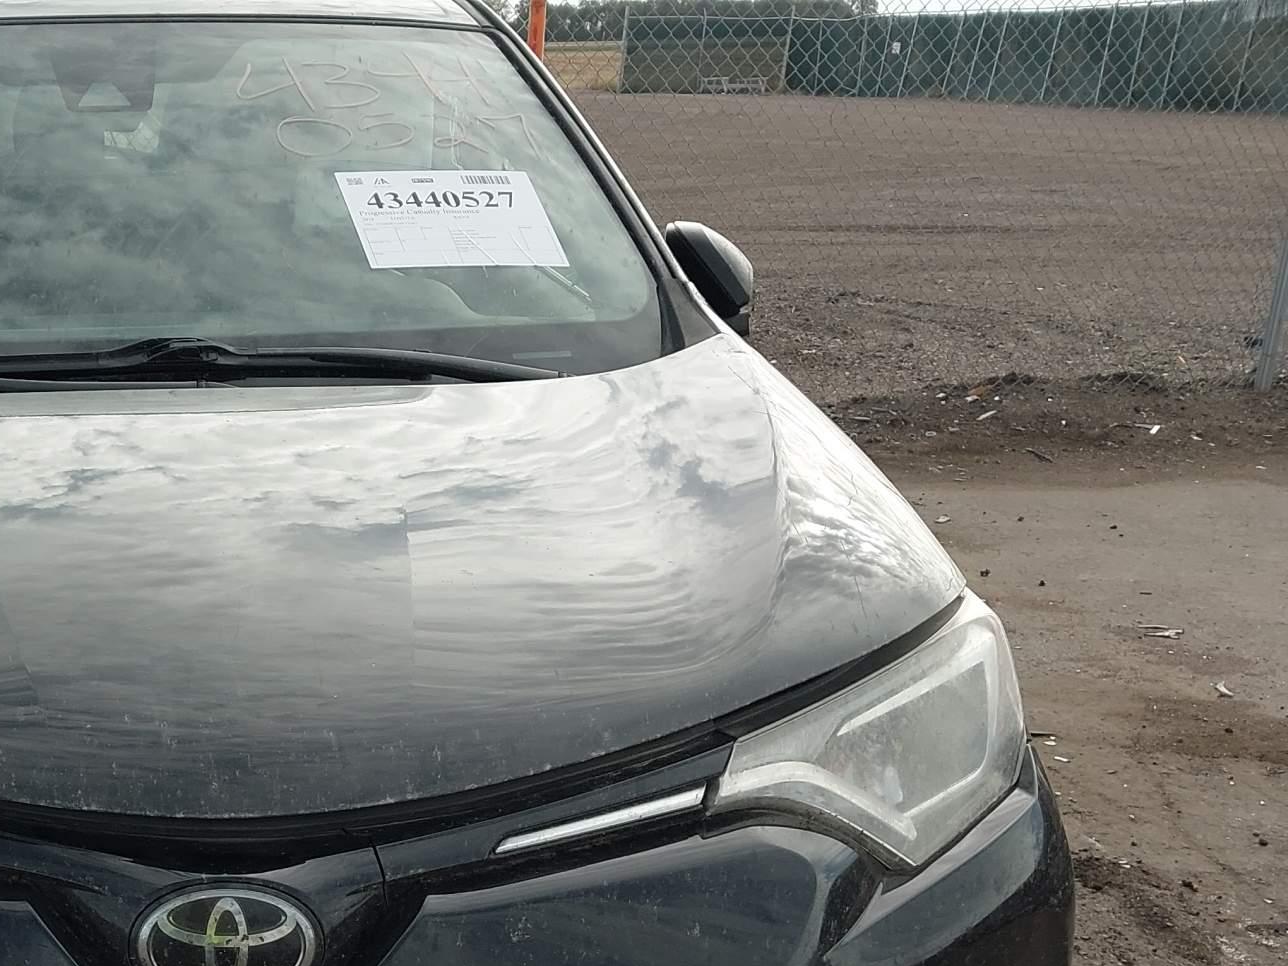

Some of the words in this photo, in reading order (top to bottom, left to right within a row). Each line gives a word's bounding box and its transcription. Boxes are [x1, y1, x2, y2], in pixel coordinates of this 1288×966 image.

[367, 191, 514, 209] 43440527
[406, 208, 440, 216] Casualty
[442, 207, 480, 215] Insurance
